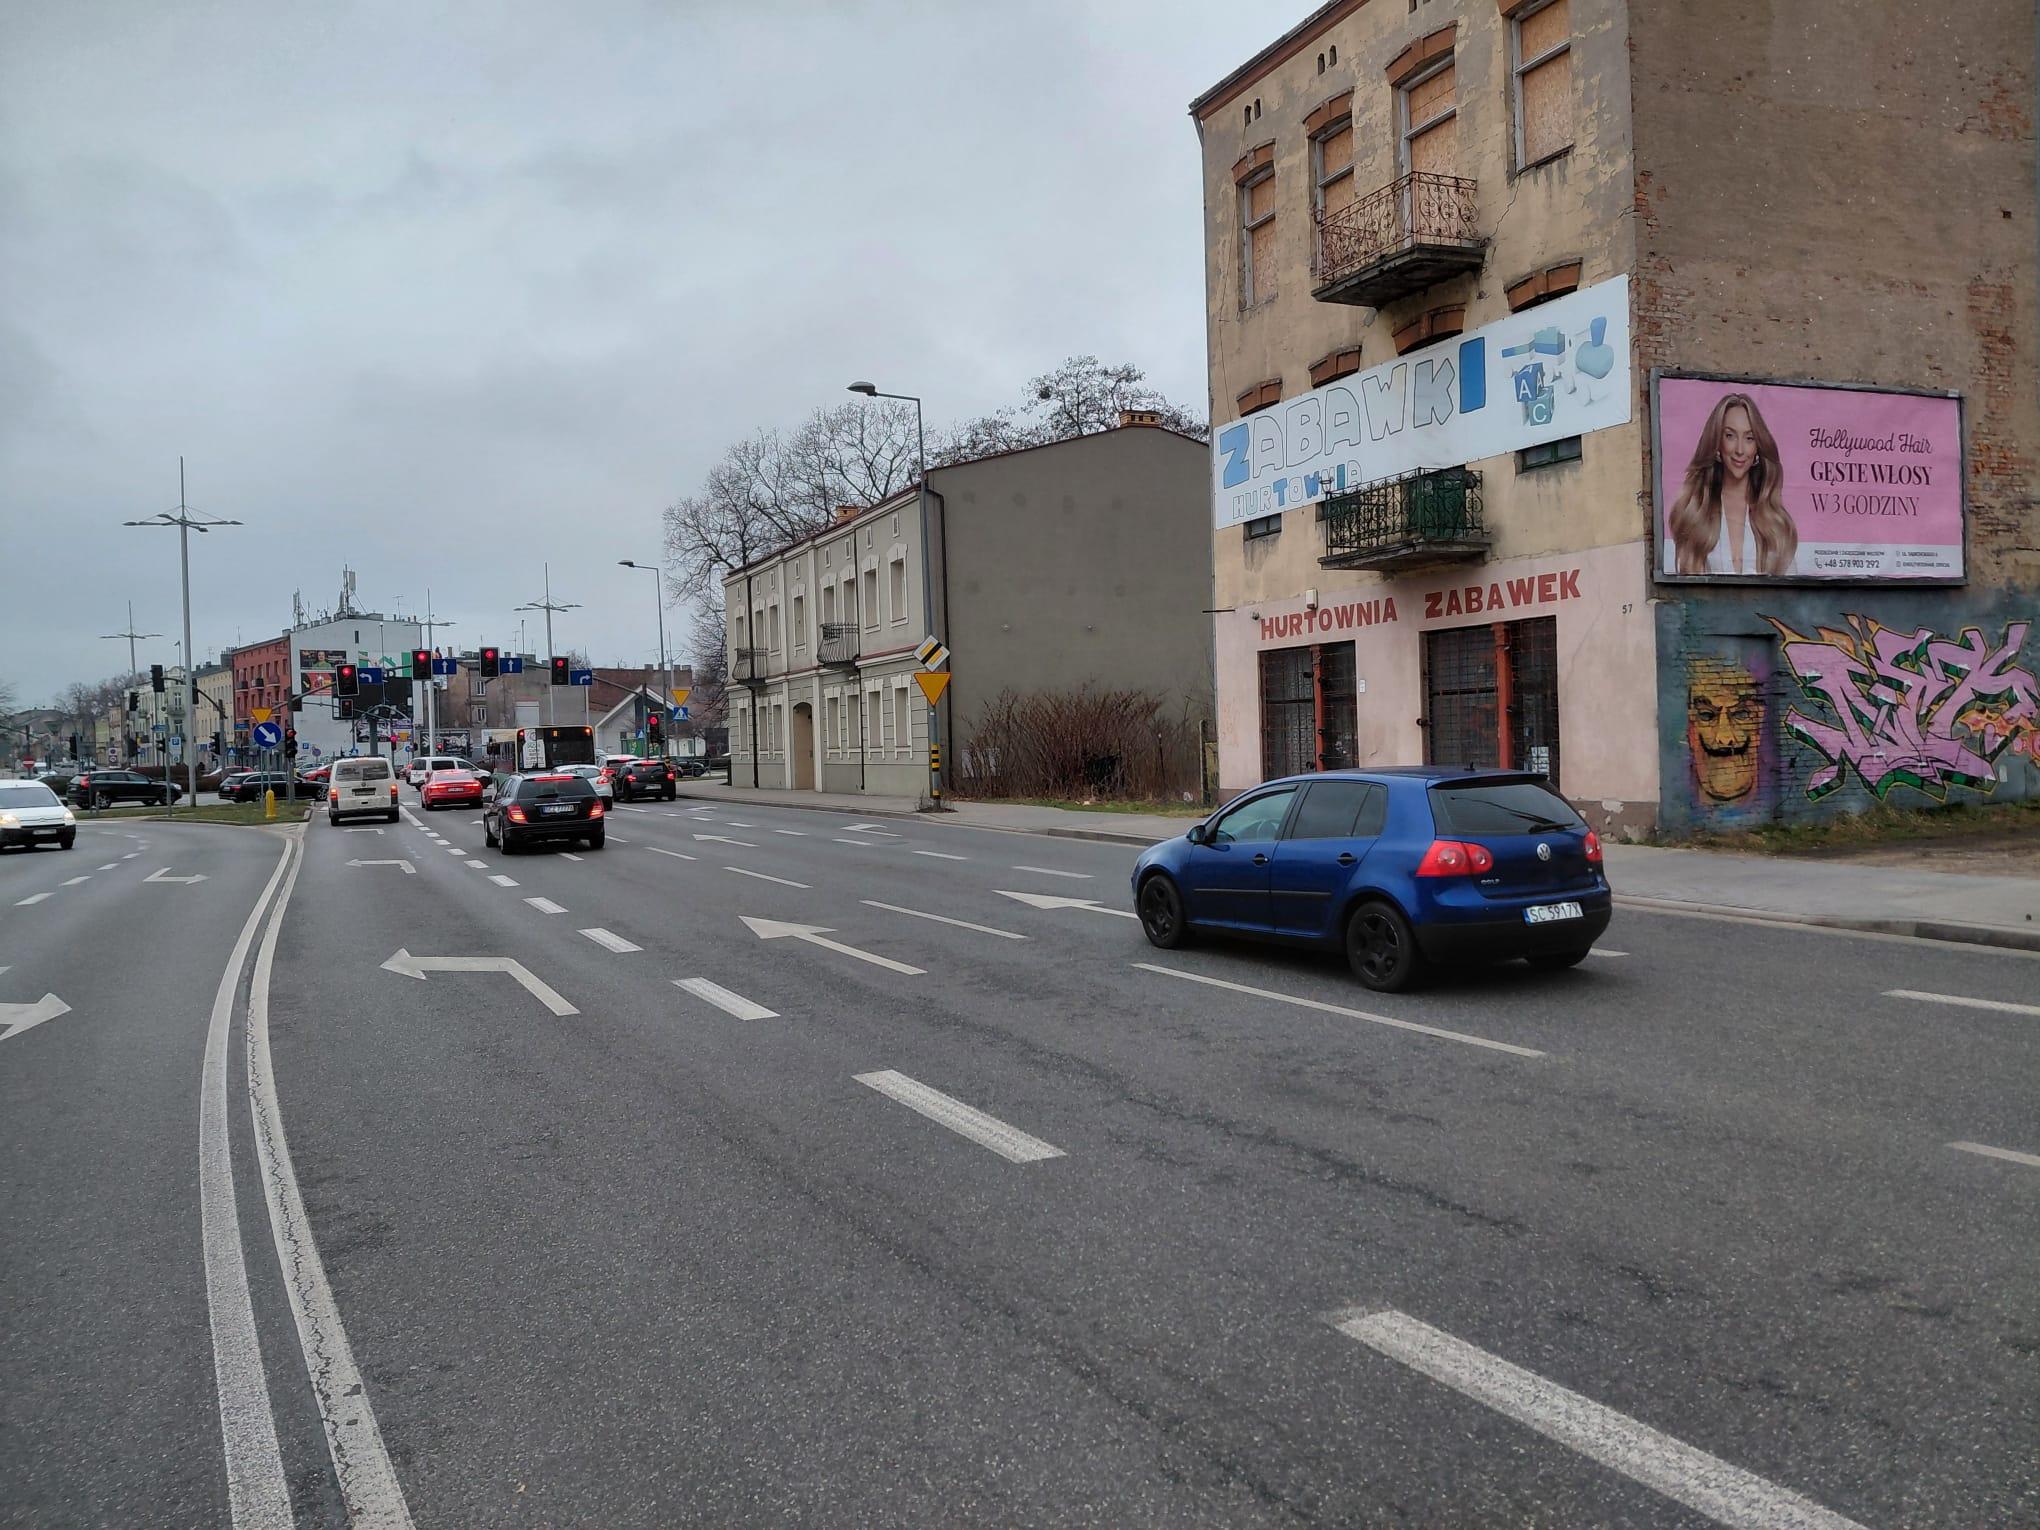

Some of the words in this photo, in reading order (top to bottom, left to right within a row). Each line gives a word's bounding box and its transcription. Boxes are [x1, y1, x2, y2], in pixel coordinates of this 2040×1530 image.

[1219, 336, 1485, 490] ZABAWKI
[1809, 427, 1895, 458] Hollywood
[1898, 432, 1934, 454] Hair
[1810, 460, 1868, 487] GĘSTE
[1870, 463, 1933, 486] WŁOSY
[1811, 492, 1829, 513] W
[1832, 493, 1841, 514] 3
[1843, 494, 1920, 516] GODZINY
[1824, 558, 1837, 568] +48
[1865, 559, 1880, 569] 292
[1260, 597, 1398, 641] HURTOWNIA
[1424, 569, 1581, 619] ZABAWEK
[1622, 604, 1633, 615] 57
[1530, 907, 1546, 922] SC
[1548, 904, 1582, 920] 5917X
